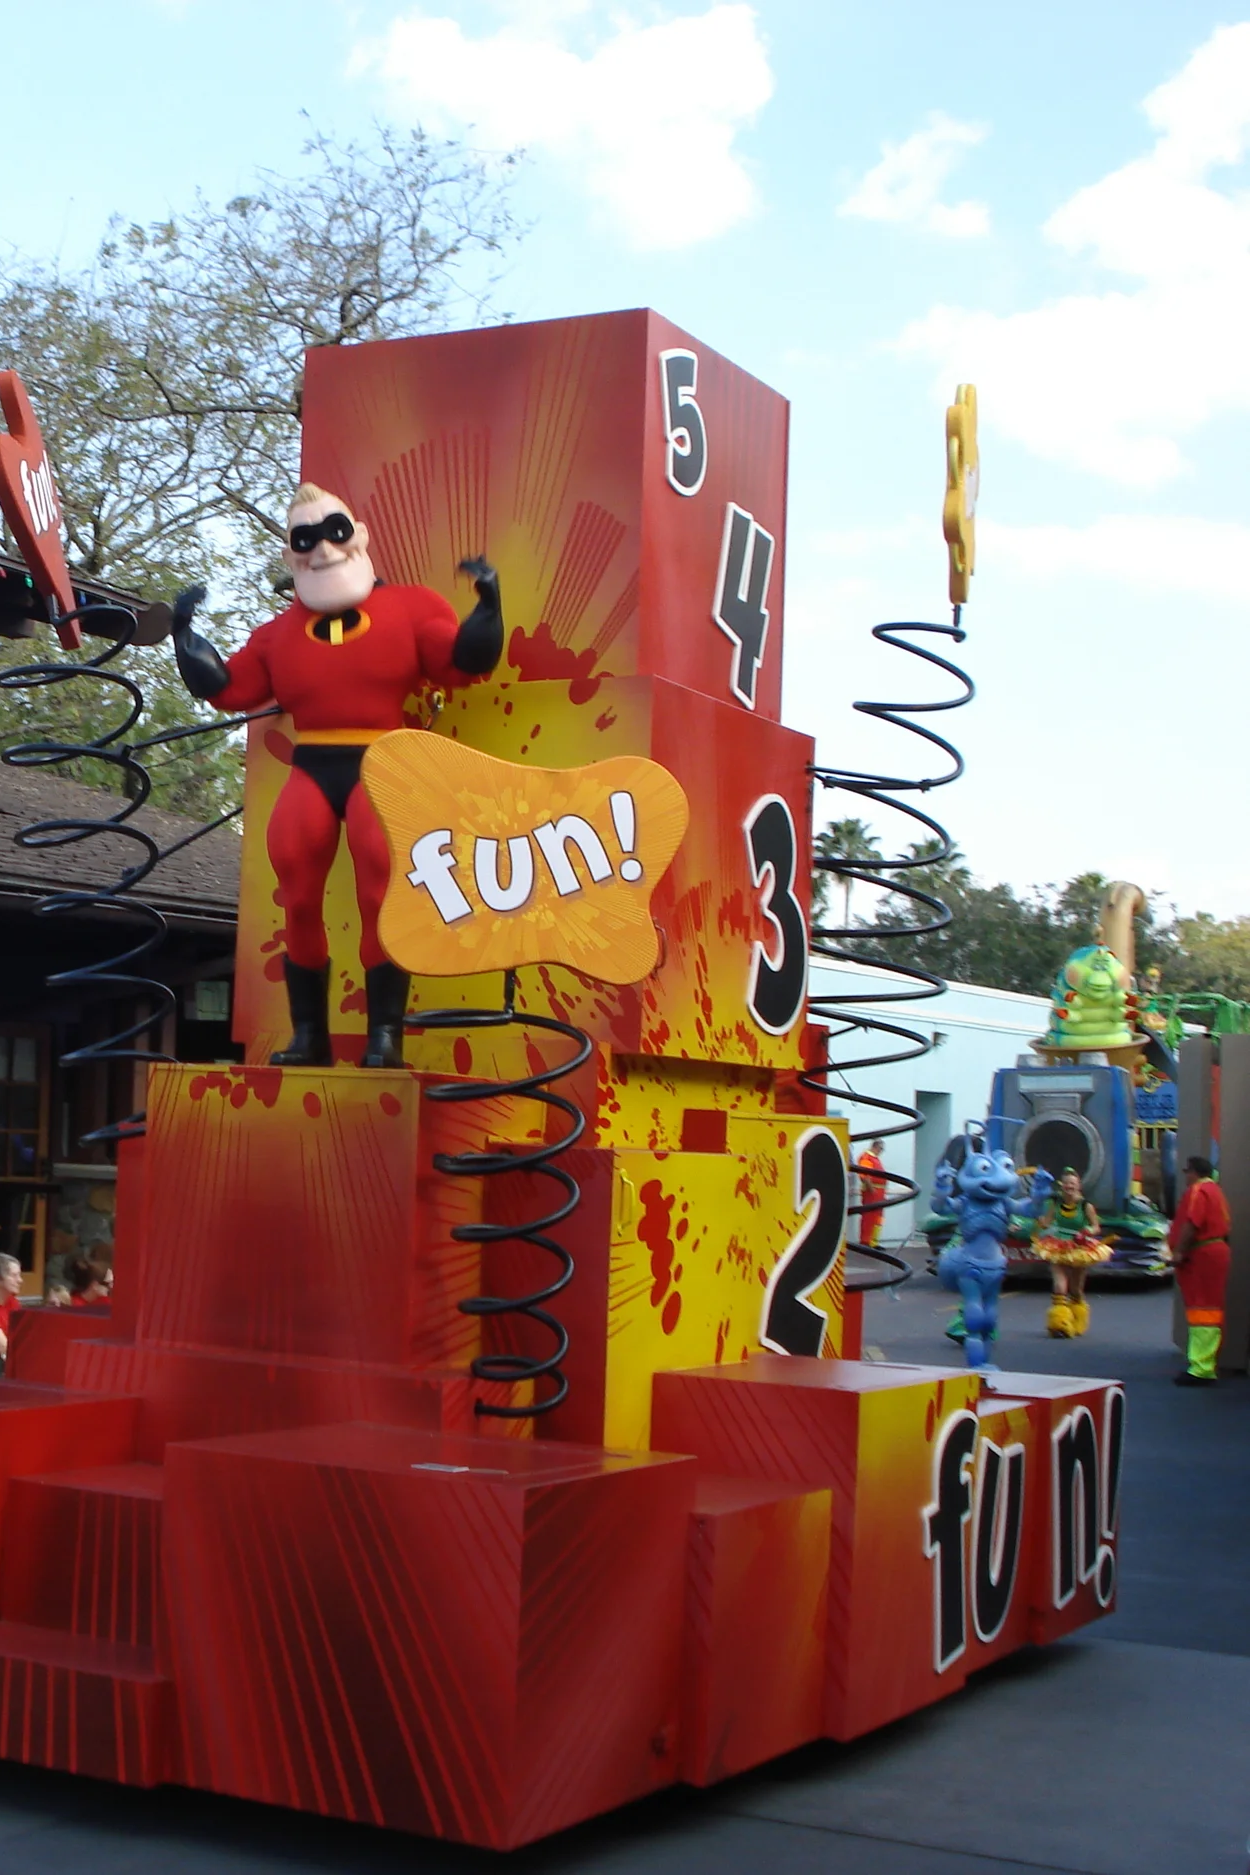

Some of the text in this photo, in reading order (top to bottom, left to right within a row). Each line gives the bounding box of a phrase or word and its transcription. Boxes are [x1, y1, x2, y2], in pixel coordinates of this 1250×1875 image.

[659, 348, 707, 497] 5
[712, 502, 775, 711] 4
[406, 790, 643, 925] fun!
[744, 793, 808, 1036] 3
[759, 1125, 847, 1358] 2
